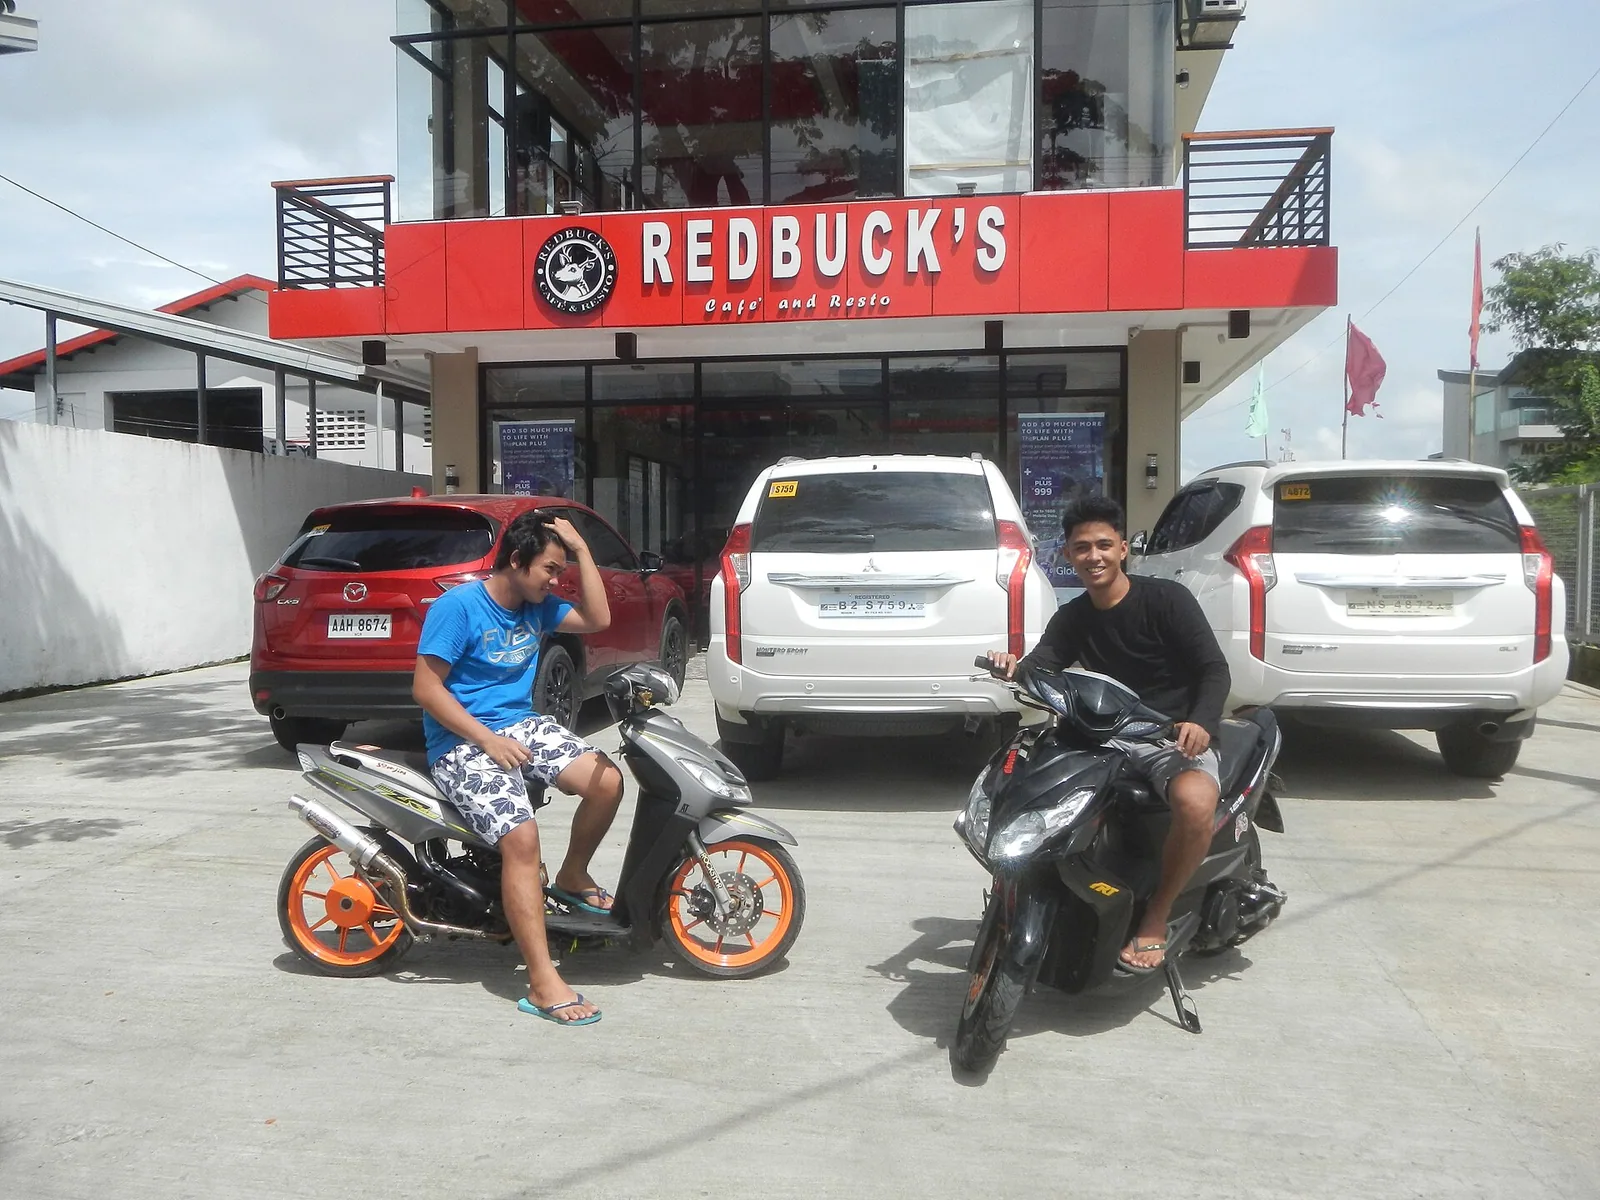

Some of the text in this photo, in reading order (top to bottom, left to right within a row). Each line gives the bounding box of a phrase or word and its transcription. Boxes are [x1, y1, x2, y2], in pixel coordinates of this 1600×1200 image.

[538, 229, 613, 261] REDBUCK'S
[642, 205, 1007, 284] REDBUCK'S
[581, 274, 613, 311] RESTO
[778, 294, 817, 309] and
[829, 293, 891, 308] Resto
[775, 484, 795, 494] S759
[1034, 487, 1053, 496] 999
[1287, 487, 1310, 496] 4872
[1056, 566, 1078, 576] Glob
[1394, 600, 1434, 609] 4872
[332, 618, 388, 632] AAH 8674
